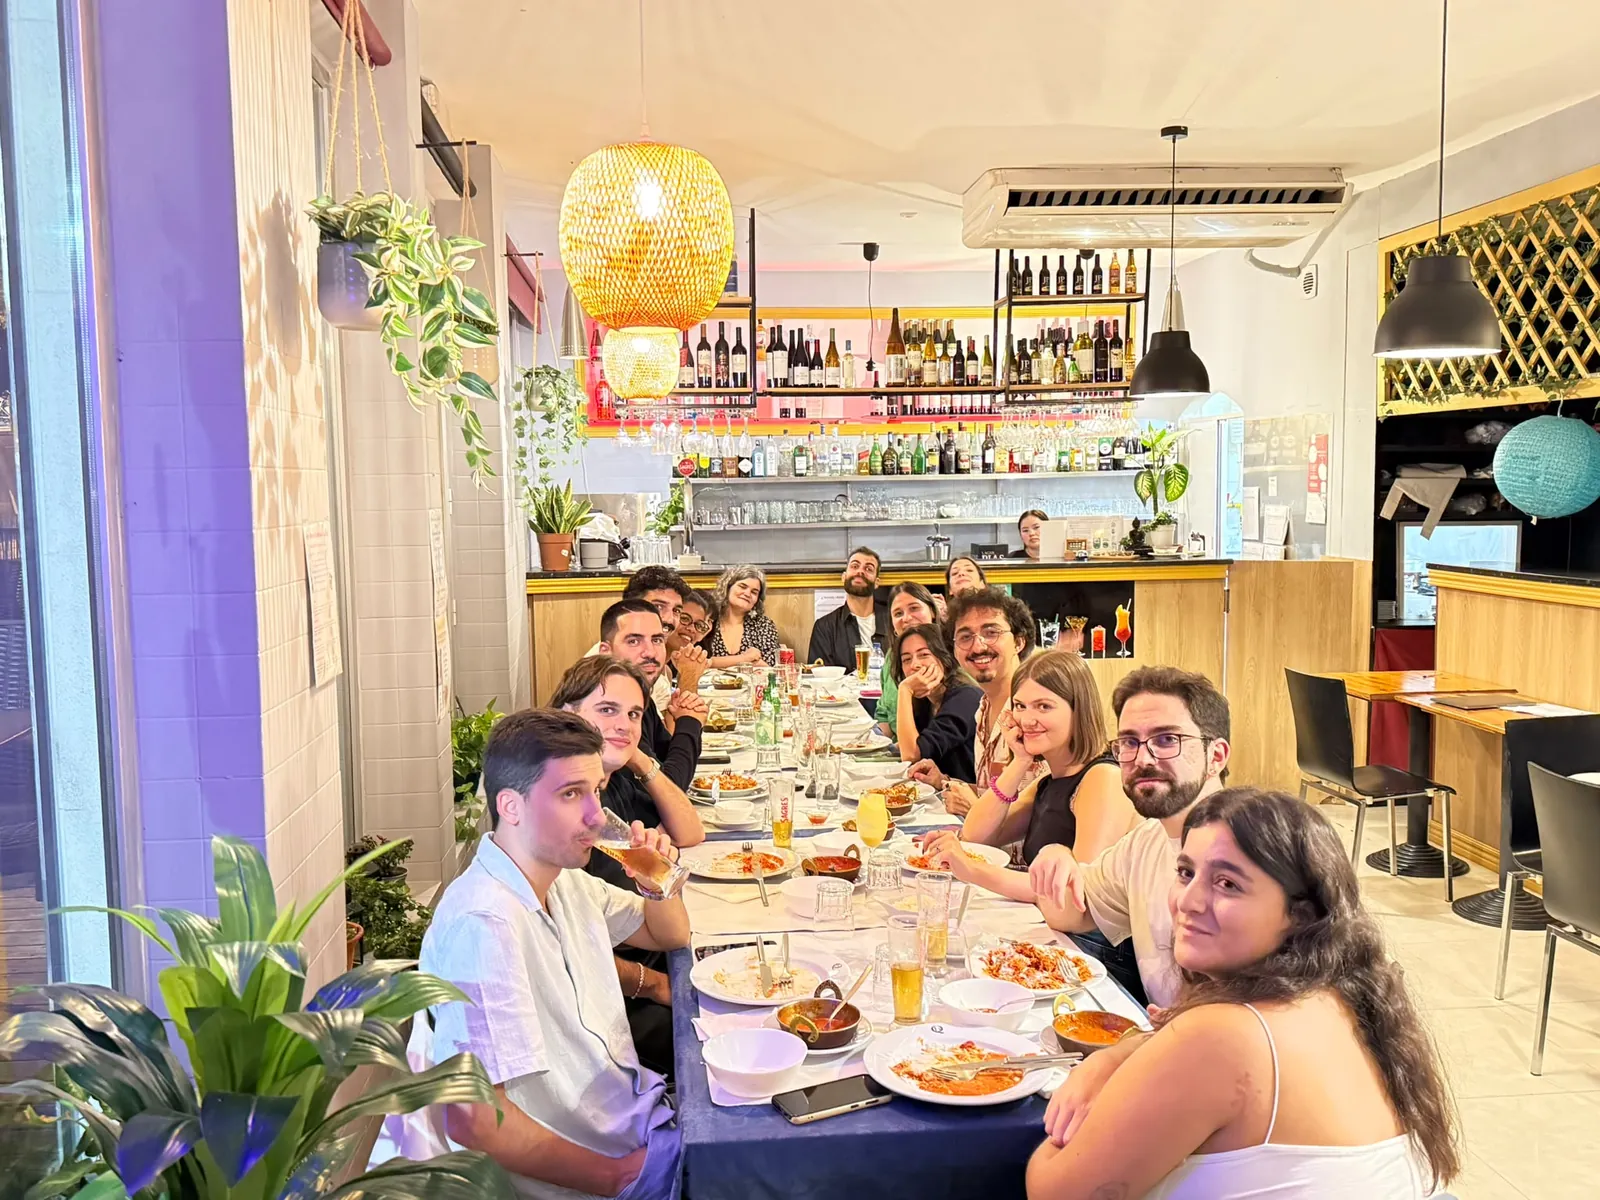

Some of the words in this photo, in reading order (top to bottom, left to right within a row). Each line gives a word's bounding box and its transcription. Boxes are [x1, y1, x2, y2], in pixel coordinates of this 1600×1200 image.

[1057, 275, 1065, 284] JP
[1094, 274, 1103, 283] JP
[1020, 359, 1030, 371] JP
[780, 797, 789, 824] SAGRES
